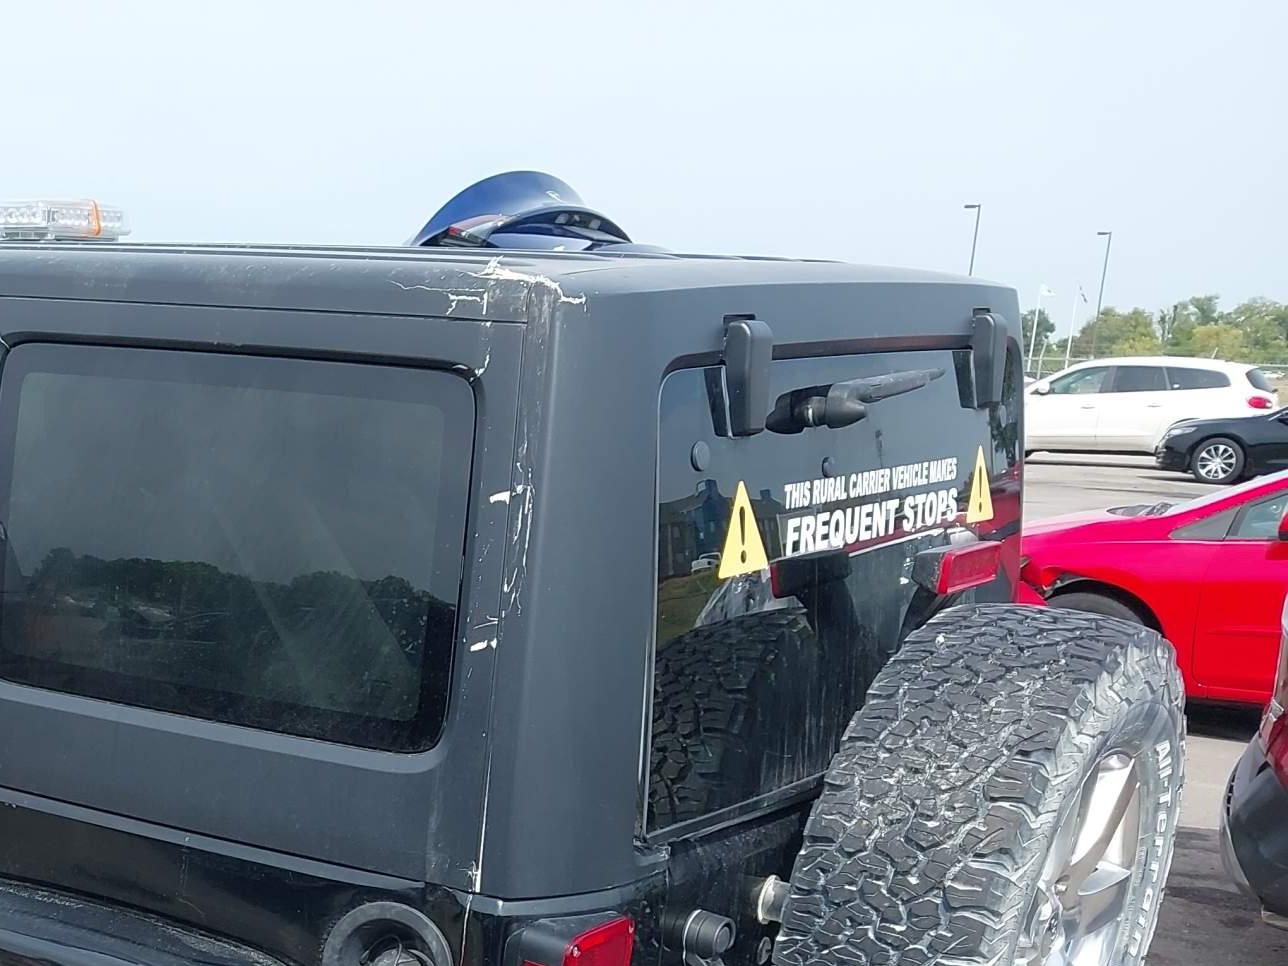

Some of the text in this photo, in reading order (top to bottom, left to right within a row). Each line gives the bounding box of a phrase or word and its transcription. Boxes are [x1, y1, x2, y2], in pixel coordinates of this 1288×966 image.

[784, 457, 958, 510] THIS RURAL CARRIER VEHICLE MAKES
[785, 487, 958, 557] FREQUENT STOPS
